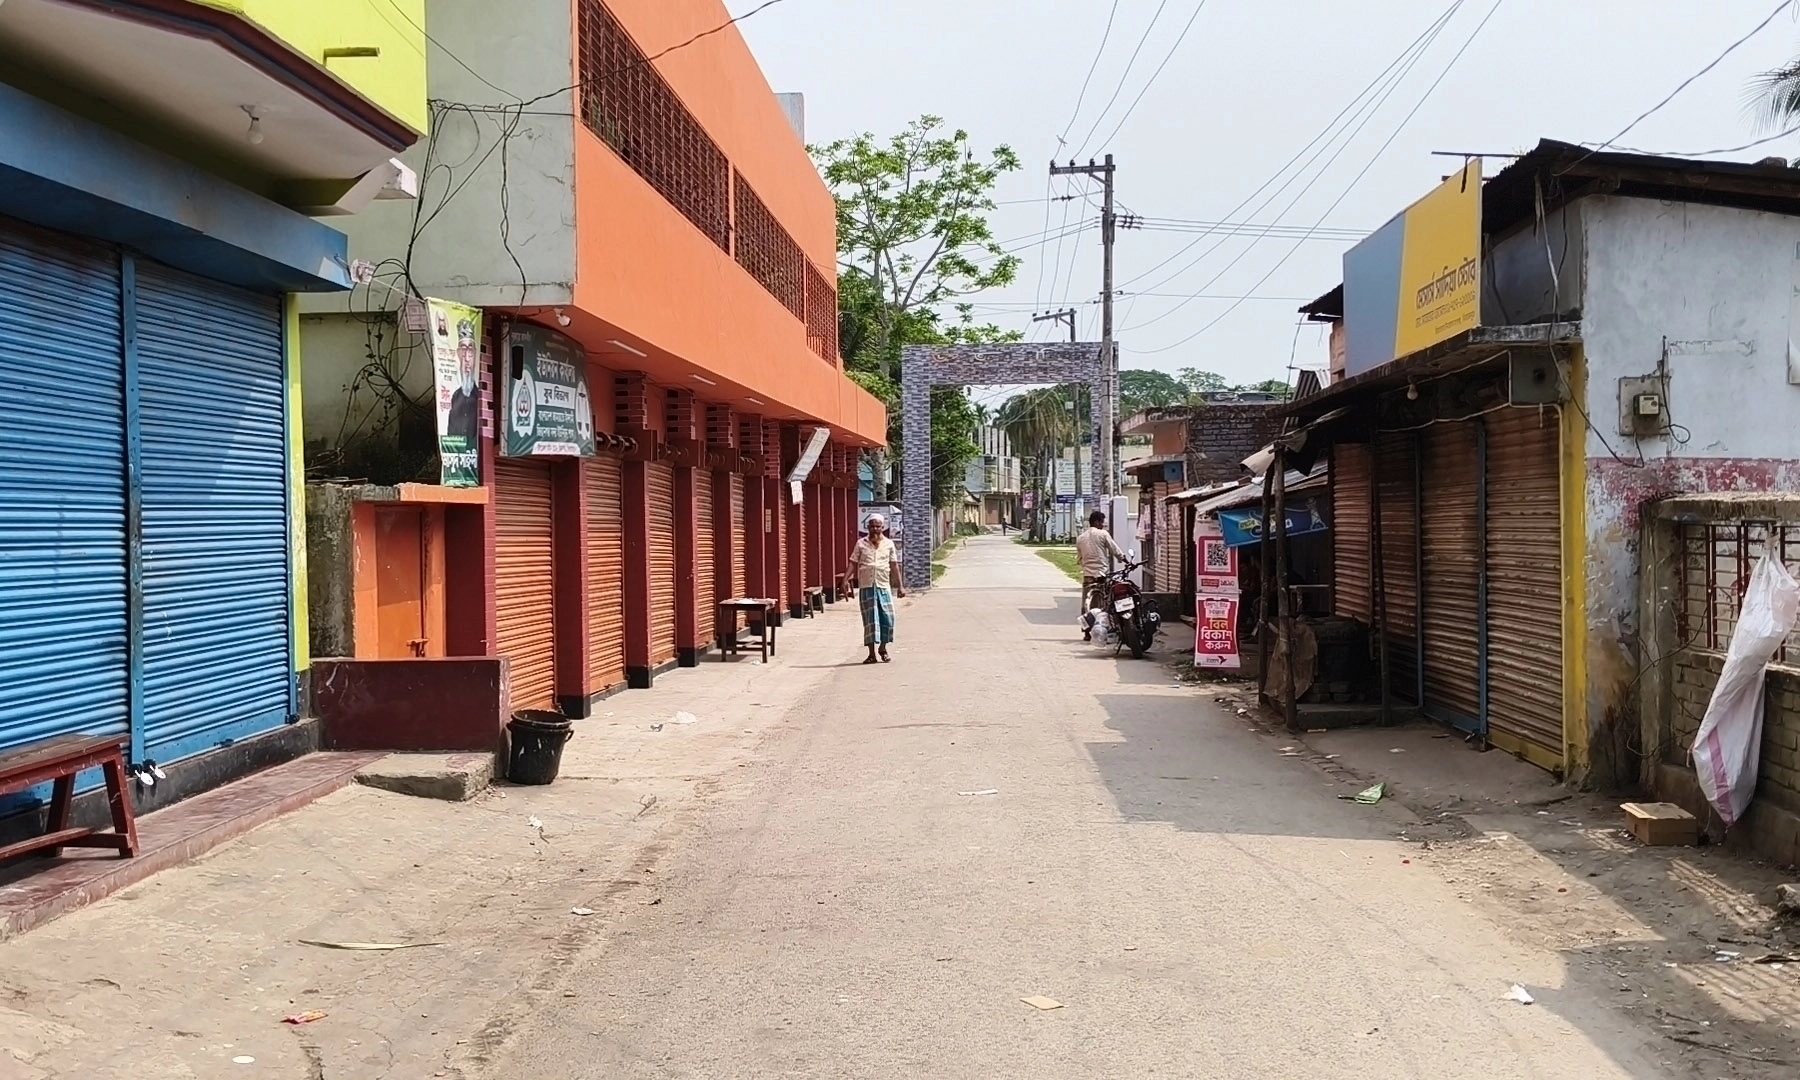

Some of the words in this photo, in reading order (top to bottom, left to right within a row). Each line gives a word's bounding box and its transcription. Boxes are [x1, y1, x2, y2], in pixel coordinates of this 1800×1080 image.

[544, 388, 552, 404] যুব
[554, 386, 569, 403] বিভাগ
[1209, 618, 1228, 630] বিল
[1201, 626, 1233, 641] বিকাশ
[1205, 640, 1231, 650] করুন
